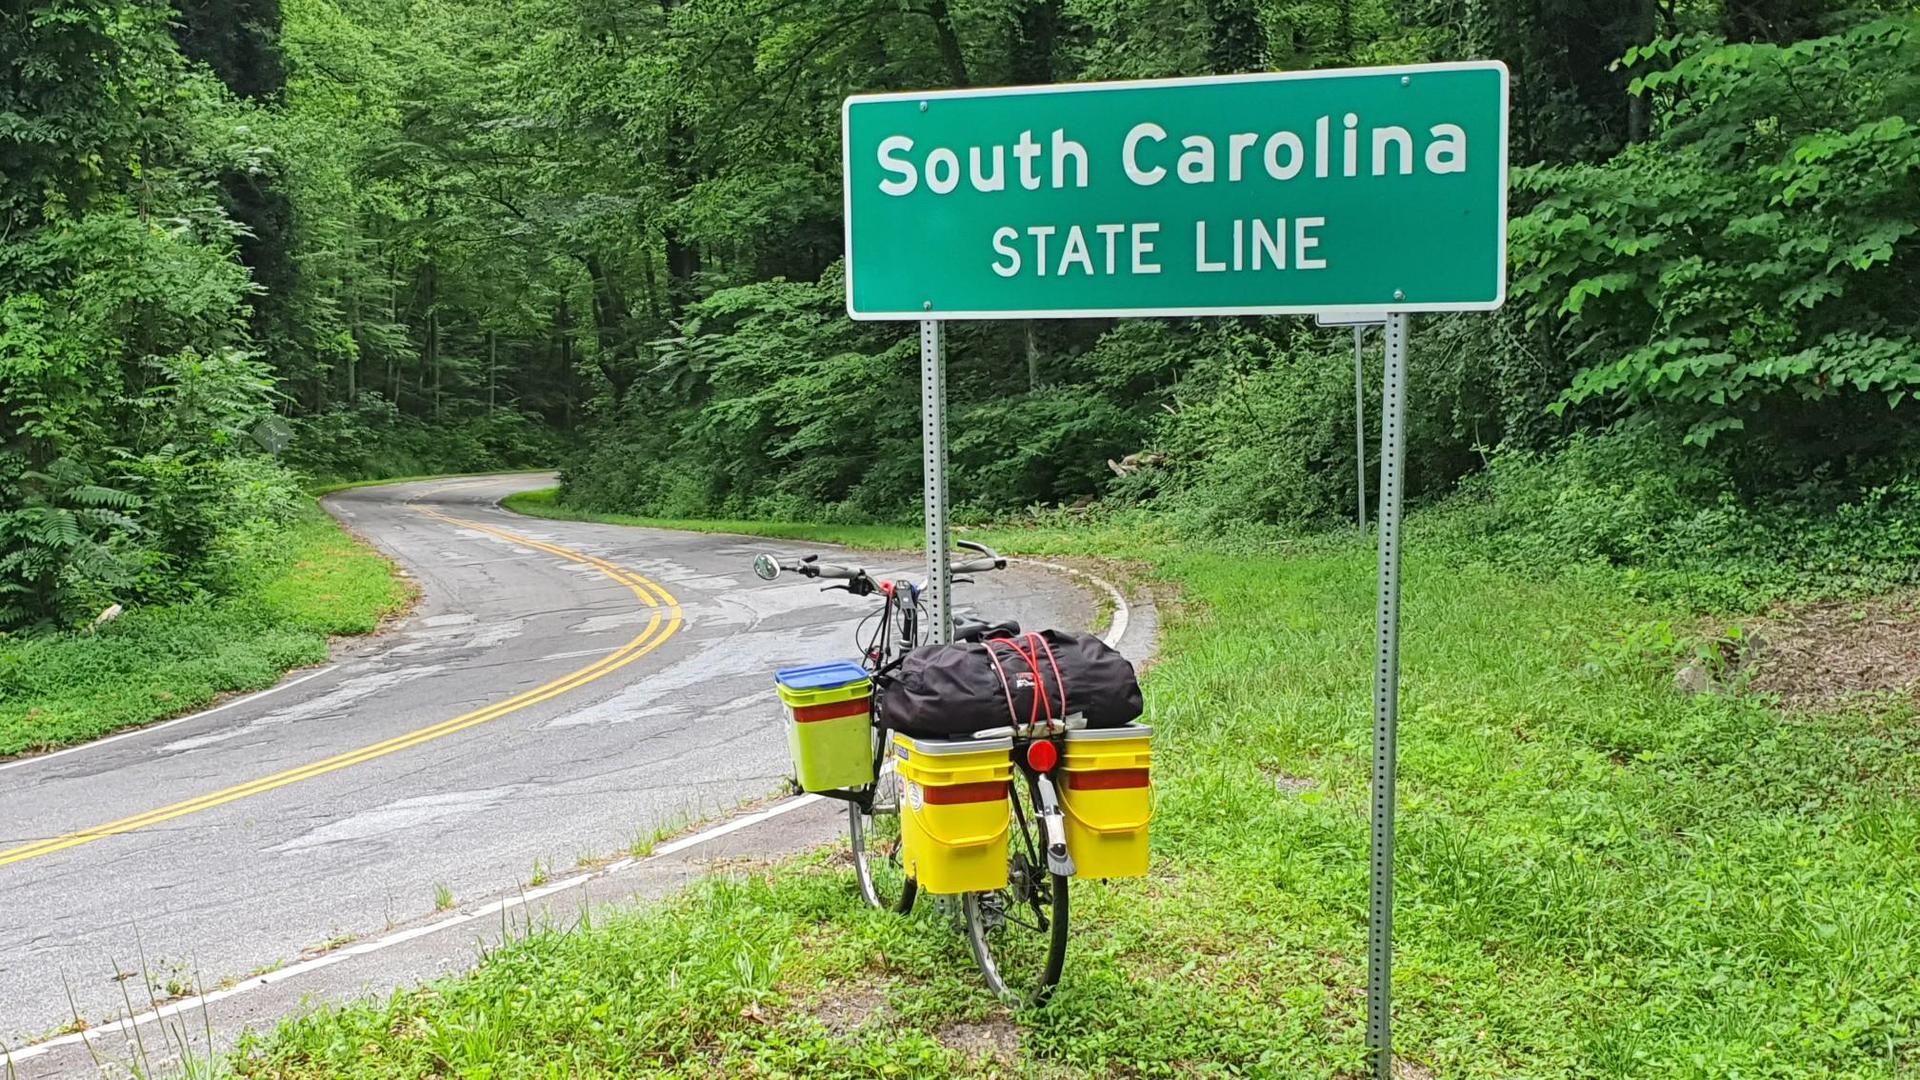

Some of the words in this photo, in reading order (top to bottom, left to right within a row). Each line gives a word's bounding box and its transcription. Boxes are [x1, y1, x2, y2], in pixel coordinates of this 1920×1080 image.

[877, 128, 1088, 196] South
[1122, 112, 1467, 186] Carolina
[991, 222, 1161, 277] STATE
[1196, 216, 1327, 272] LINE
